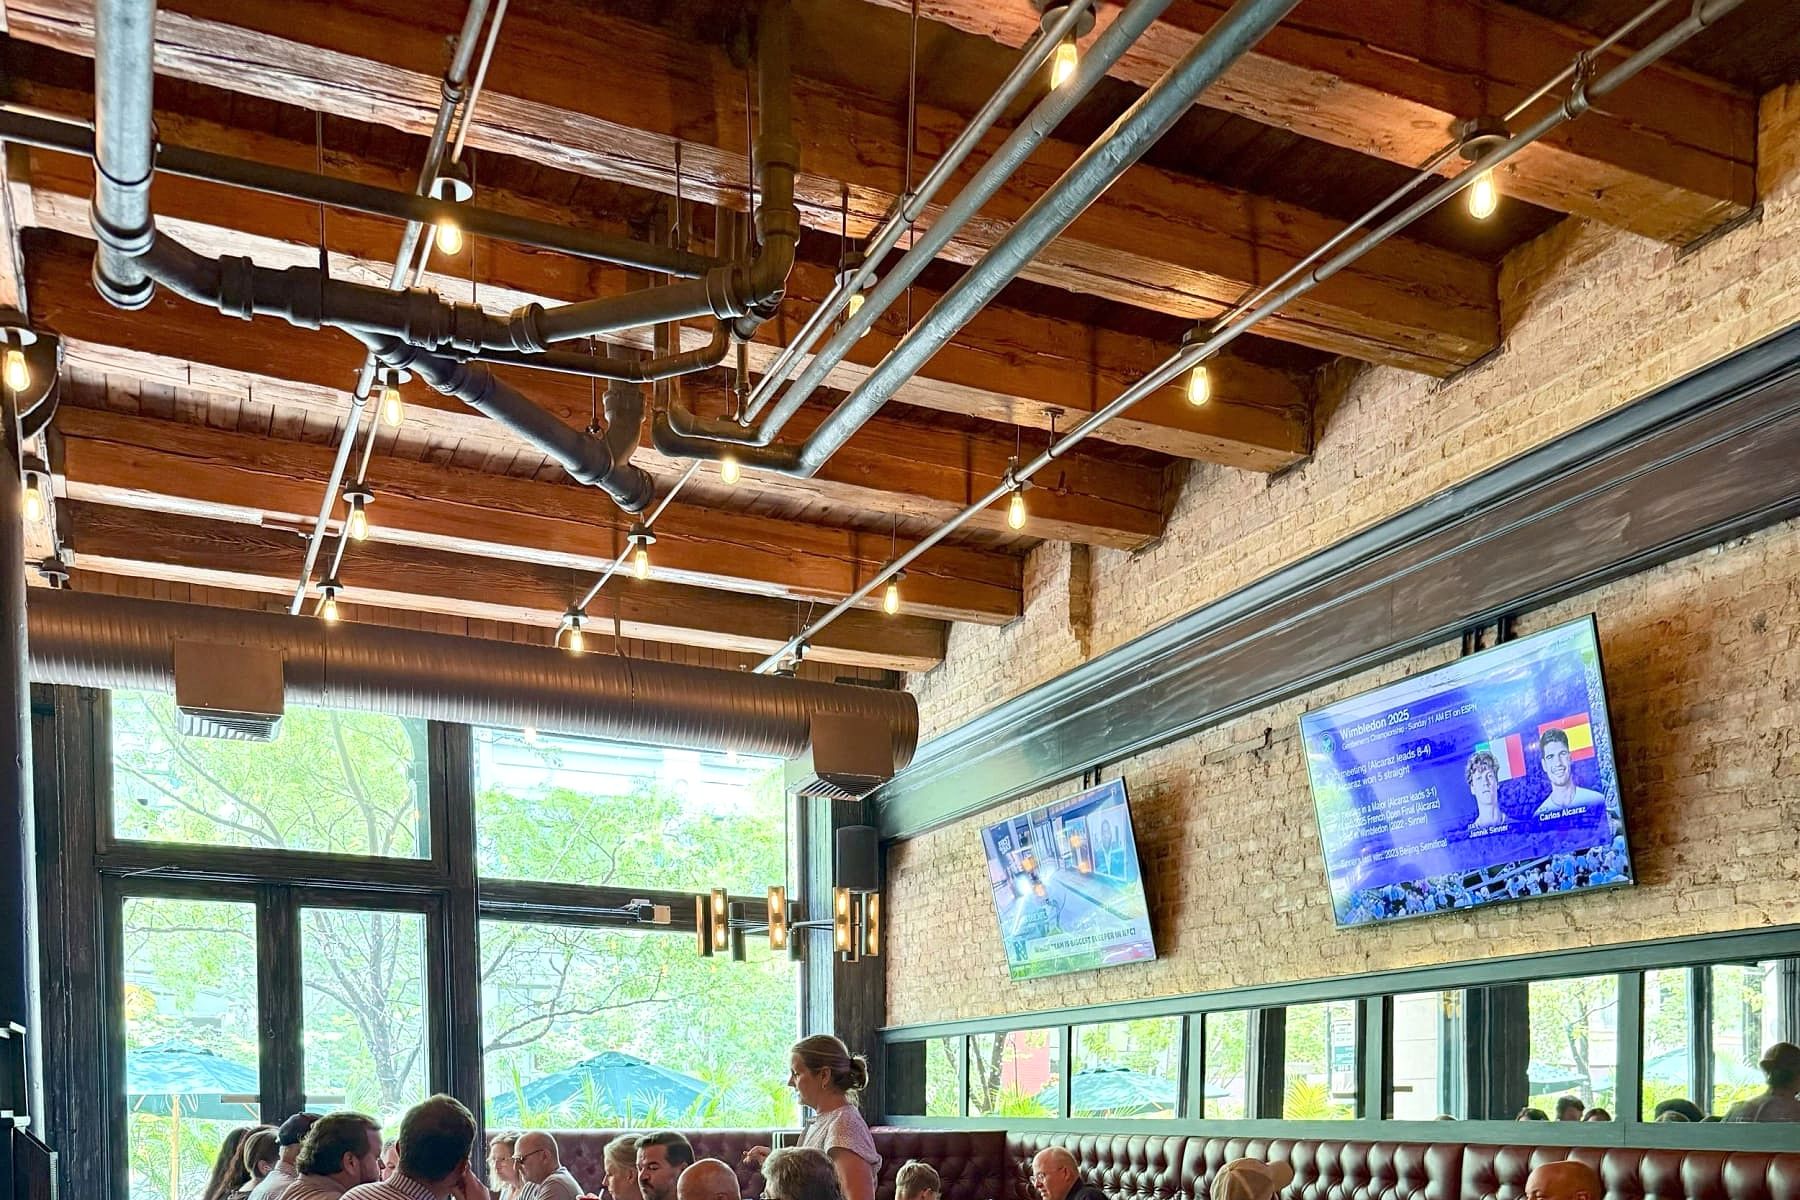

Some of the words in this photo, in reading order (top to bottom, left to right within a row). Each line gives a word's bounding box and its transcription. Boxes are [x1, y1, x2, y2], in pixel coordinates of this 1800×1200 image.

[1340, 717, 1387, 740] Wimbledon
[1387, 709, 1409, 725] 2025
[1408, 718, 1427, 732] Sunday
[1434, 713, 1444, 722] AM
[1367, 755, 1395, 770] (Alcaraz
[1396, 749, 1416, 762] leads
[1363, 777, 1376, 785] won
[1384, 765, 1410, 781] straight
[1425, 787, 1437, 799] 3-1)
[1367, 812, 1386, 824] French
[1540, 811, 1560, 821] Carlos
[1561, 805, 1586, 817] Alcaraz
[1469, 828, 1488, 838] Jannik
[1489, 824, 1508, 834] Sinner
